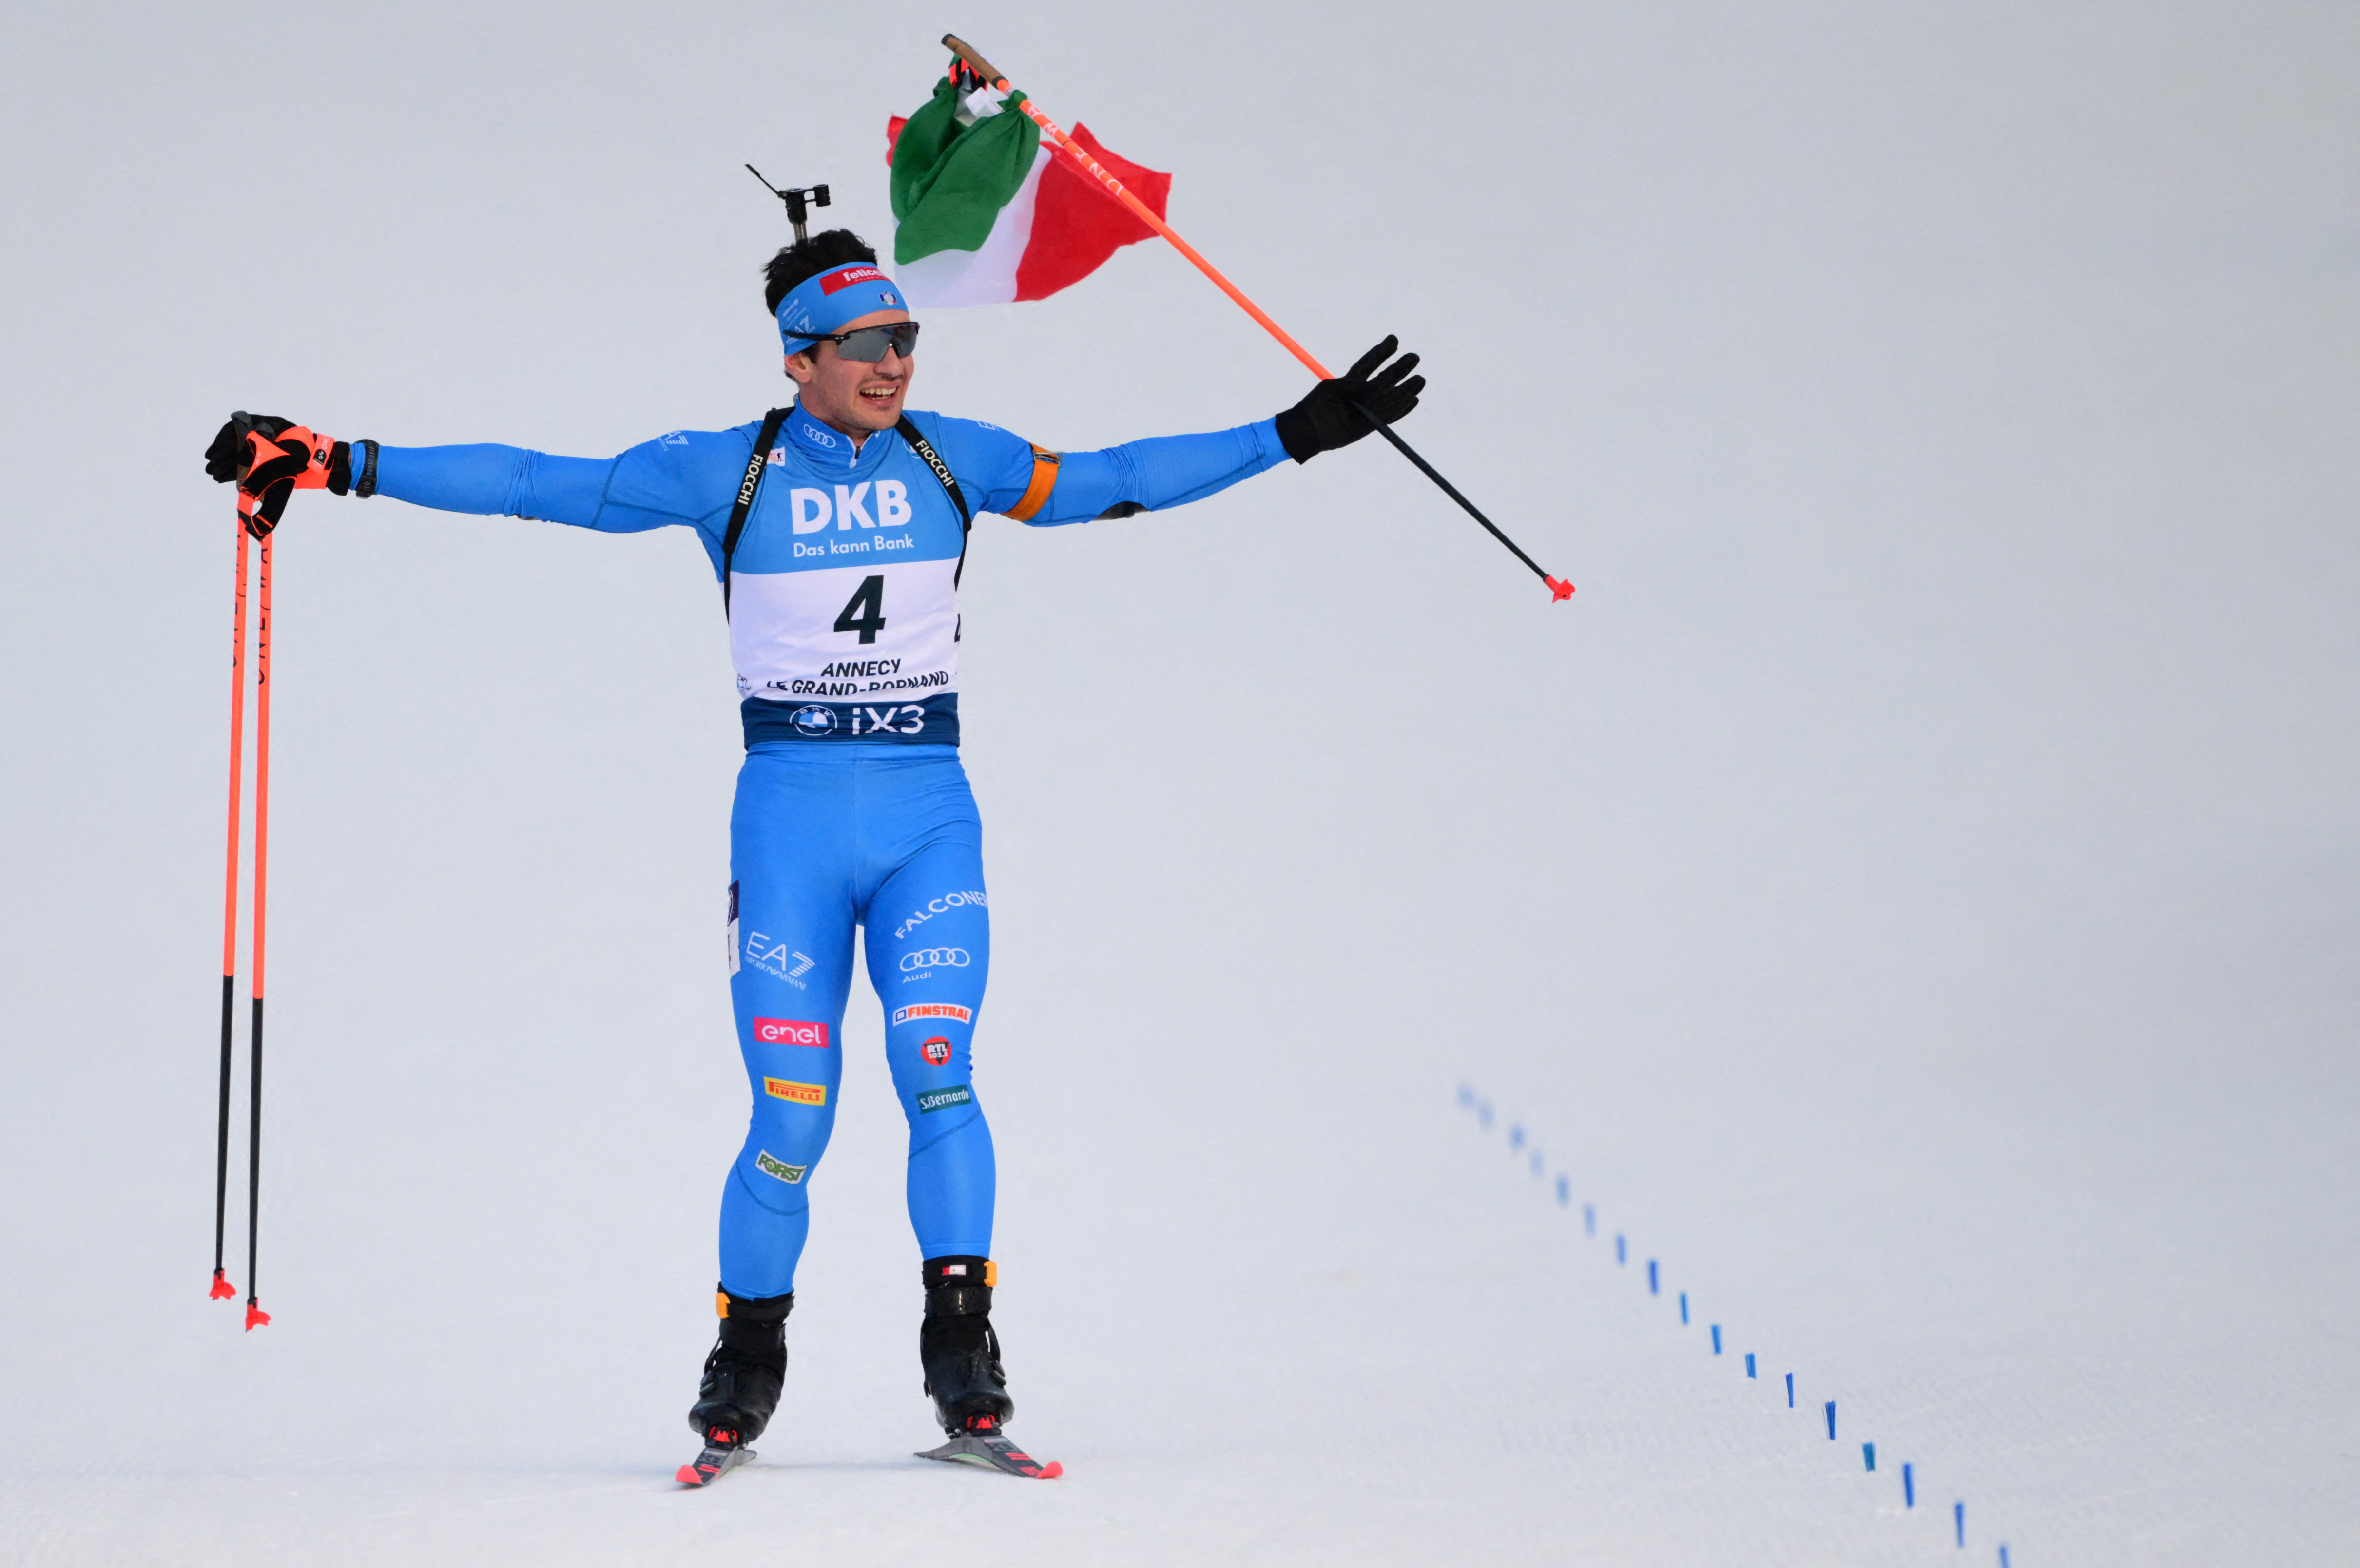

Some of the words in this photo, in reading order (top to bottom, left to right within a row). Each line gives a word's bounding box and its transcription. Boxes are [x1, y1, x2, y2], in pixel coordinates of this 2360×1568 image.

[1027, 106, 1059, 138] WA
[843, 269, 885, 282] felice
[916, 440, 954, 487] FIOCCHI
[738, 454, 763, 505] FIOCCHI
[790, 479, 912, 535] DKB
[793, 541, 825, 557] Das
[830, 536, 870, 555] kann
[874, 534, 914, 550] Bank
[833, 575, 886, 645] 4
[820, 658, 901, 677] ANNECY
[852, 704, 925, 734] iX3
[746, 931, 816, 977] EA7
[745, 955, 771, 972] EMPORIO
[776, 972, 807, 990] ARMANI
[903, 972, 932, 984] Audi
[908, 1005, 968, 1021] FINSTRAL
[761, 1025, 821, 1044] enel
[927, 1043, 948, 1053] RTL
[768, 1081, 821, 1101] PIRELLI
[758, 1153, 805, 1181] FORST
